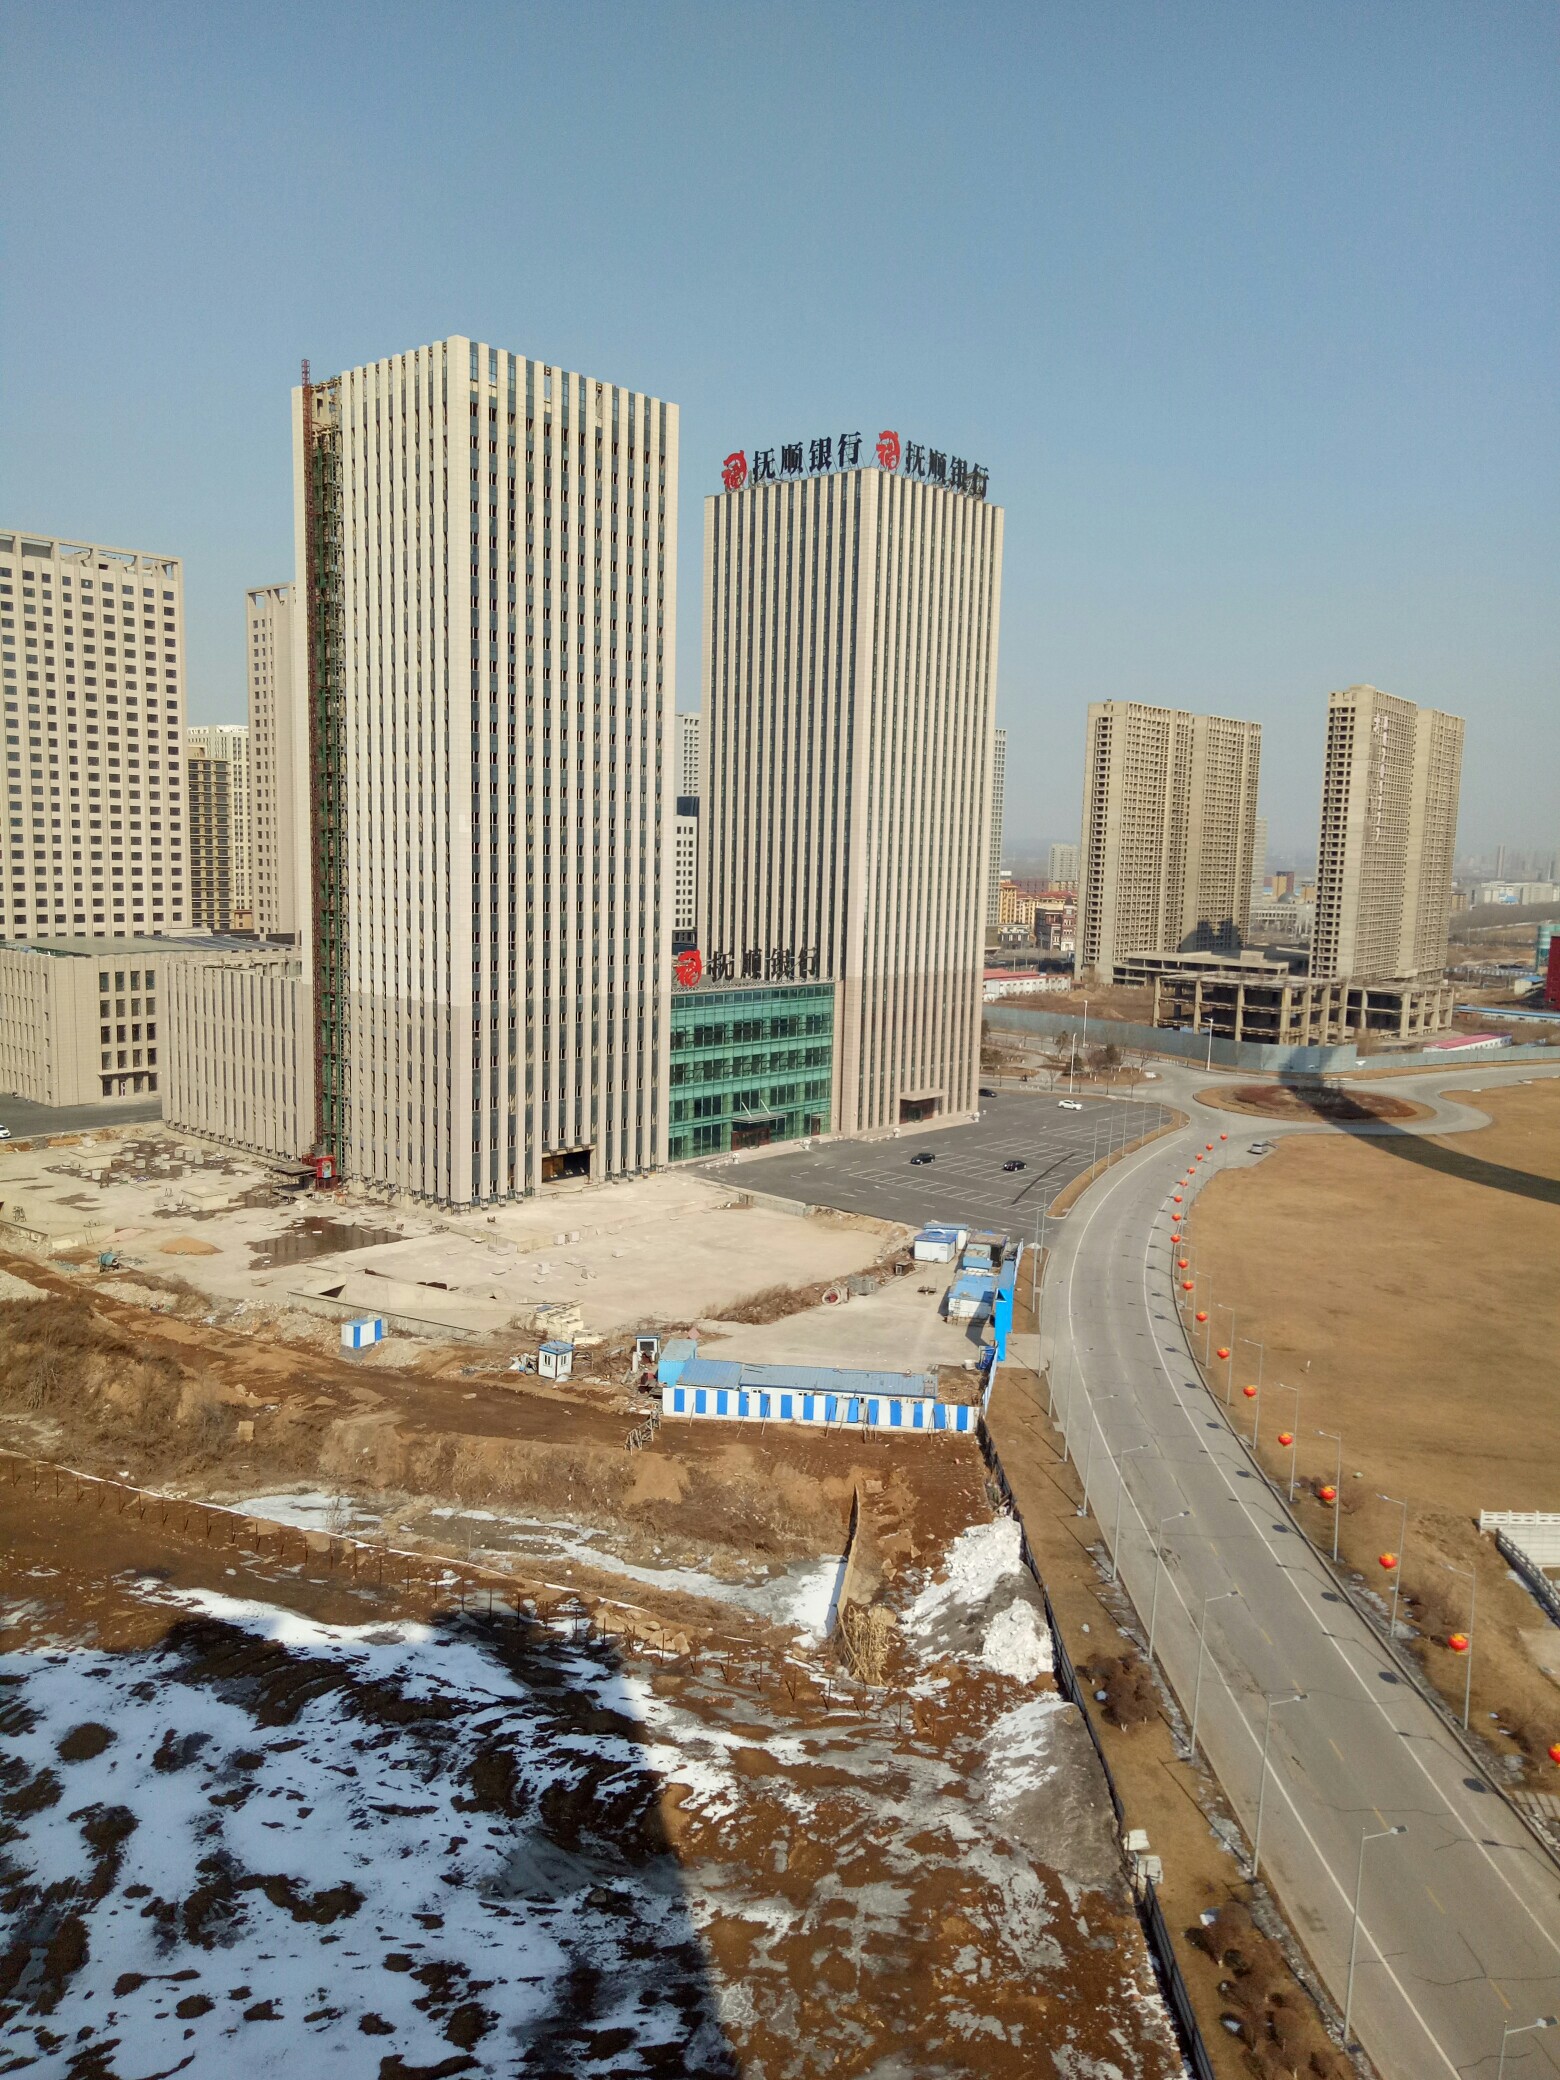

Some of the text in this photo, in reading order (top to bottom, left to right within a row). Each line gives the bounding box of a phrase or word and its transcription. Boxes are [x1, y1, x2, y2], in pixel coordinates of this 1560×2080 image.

[753, 431, 863, 483] 抚顺银行
[905, 440, 990, 500] 抚顺银行
[711, 947, 817, 983] 抚顺银行
